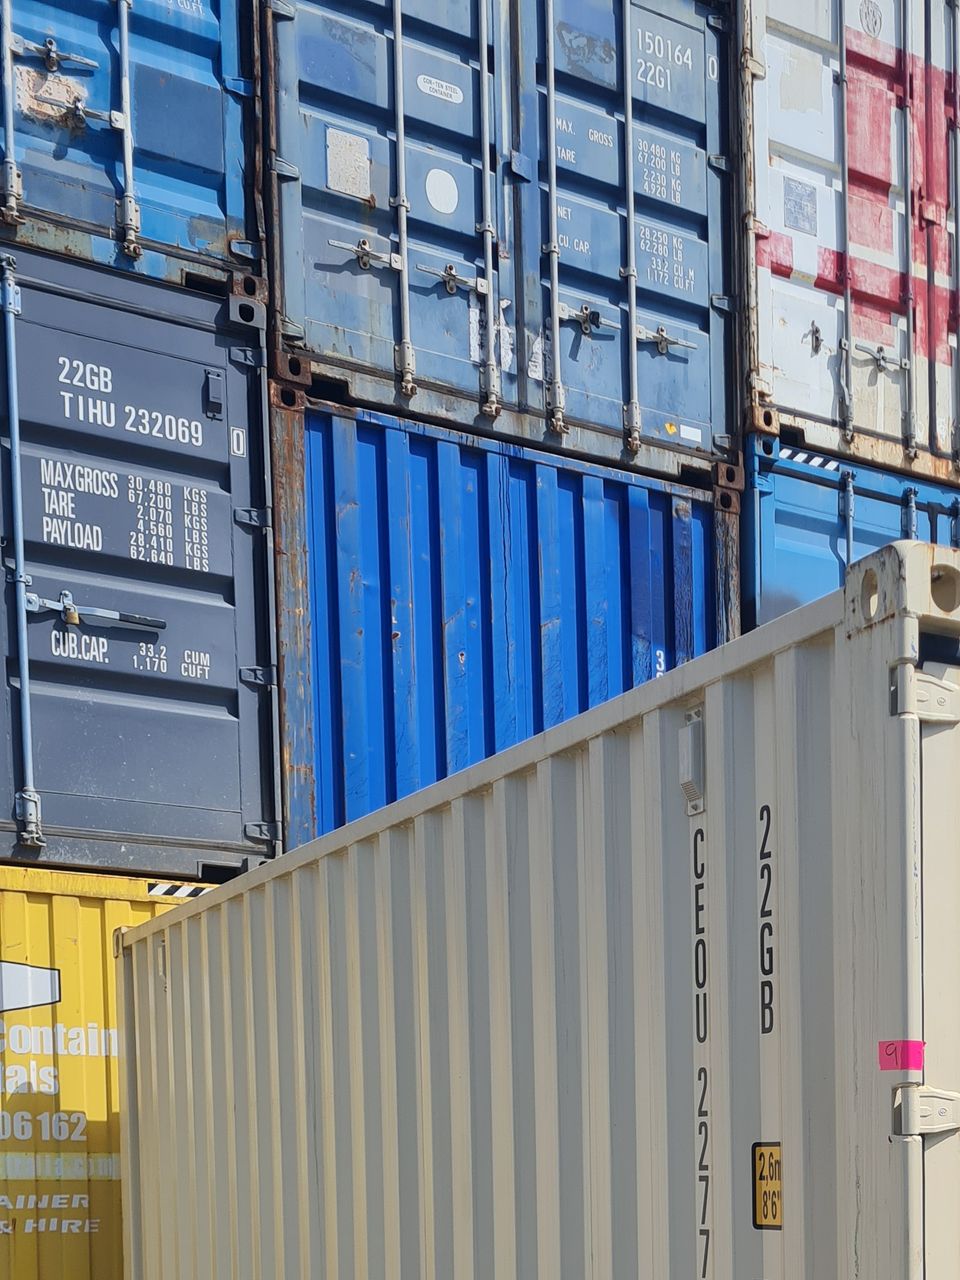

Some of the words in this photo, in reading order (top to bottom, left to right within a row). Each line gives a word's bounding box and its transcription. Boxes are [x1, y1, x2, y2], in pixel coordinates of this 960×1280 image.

[637, 29, 692, 71] 150164
[708, 55, 718, 81] 0
[637, 58, 672, 91] 22G1
[555, 117, 576, 136] MAX.
[588, 128, 614, 149] GROSS
[556, 145, 577, 164] TARE
[670, 149, 682, 164] KG
[670, 161, 681, 177] LB
[671, 178, 682, 193] KG
[671, 189, 682, 205] LB
[557, 205, 572, 221] NET
[672, 236, 684, 250] KG
[673, 247, 683, 262] LB
[58, 356, 113, 393] 22GB
[59, 391, 117, 428] TIHU
[124, 405, 203, 447] 232069
[232, 428, 245, 456] 0
[41, 487, 76, 519] TARE
[183, 486, 207, 503] KGS
[184, 502, 208, 518] LBS
[184, 514, 208, 532] KGS
[42, 516, 102, 552] PAYLOAD
[185, 528, 209, 546] LBS
[185, 541, 209, 559] KGS
[185, 556, 209, 573] LBS
[139, 642, 168, 660] 33.2
[184, 650, 210, 666] CUM
[181, 662, 210, 680] CUFT
[759, 804, 774, 1035] 22GB
[693, 827, 708, 1044] CEOU
[0, 1018, 119, 1057] ontain
[0, 1060, 59, 1096] als
[25, 1218, 101, 1233] HIRE
